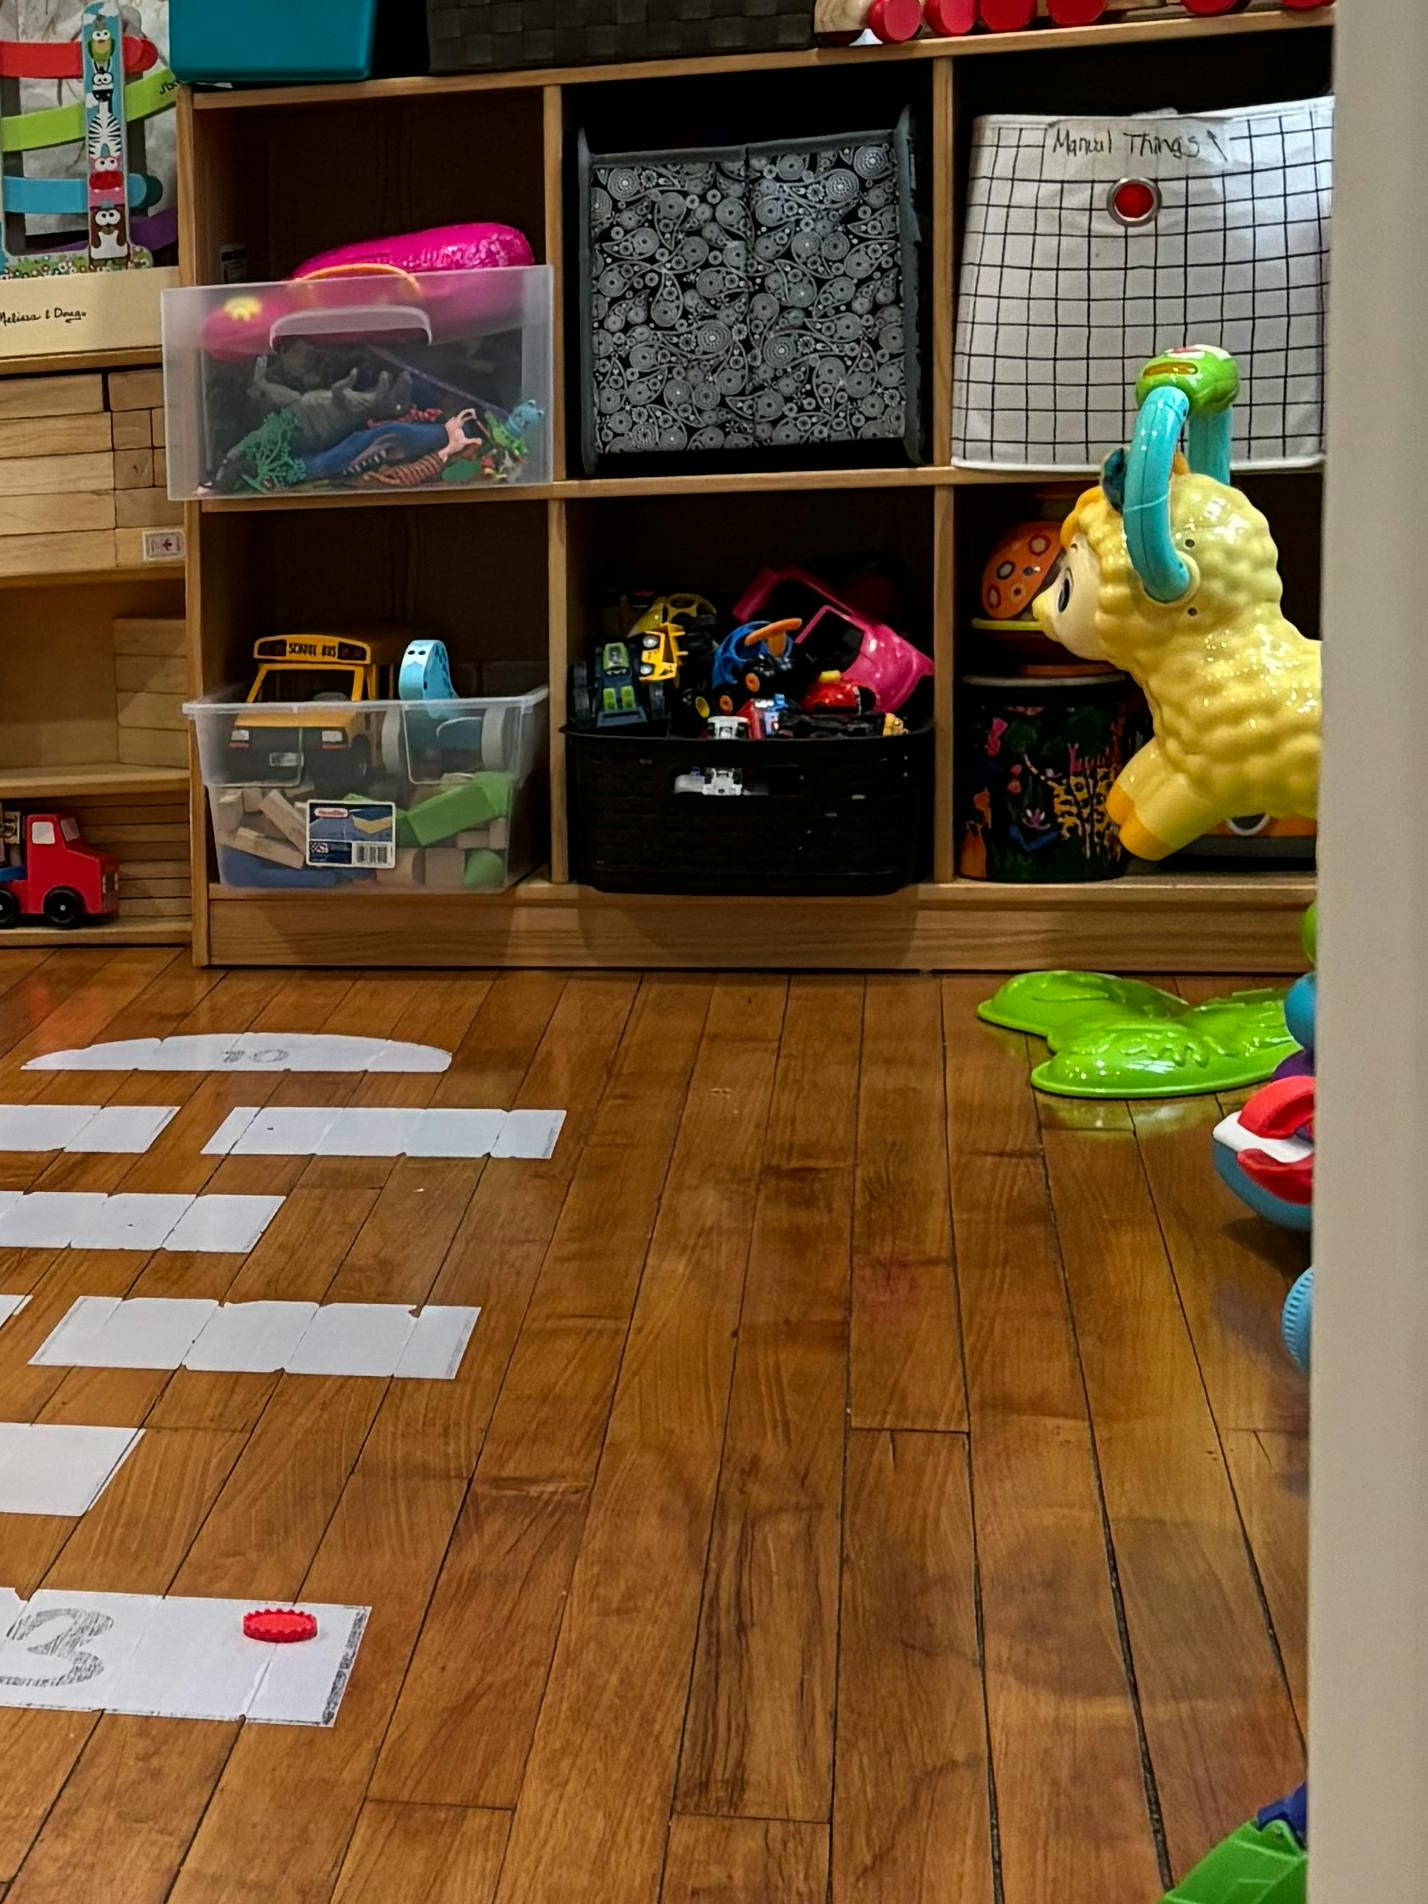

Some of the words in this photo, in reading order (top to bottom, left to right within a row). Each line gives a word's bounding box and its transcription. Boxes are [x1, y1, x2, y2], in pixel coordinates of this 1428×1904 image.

[1123, 130, 1201, 159] Things
[53, 307, 87, 324] Doug
[288, 642, 317, 657] SCHOOL
[321, 642, 337, 658] BUS
